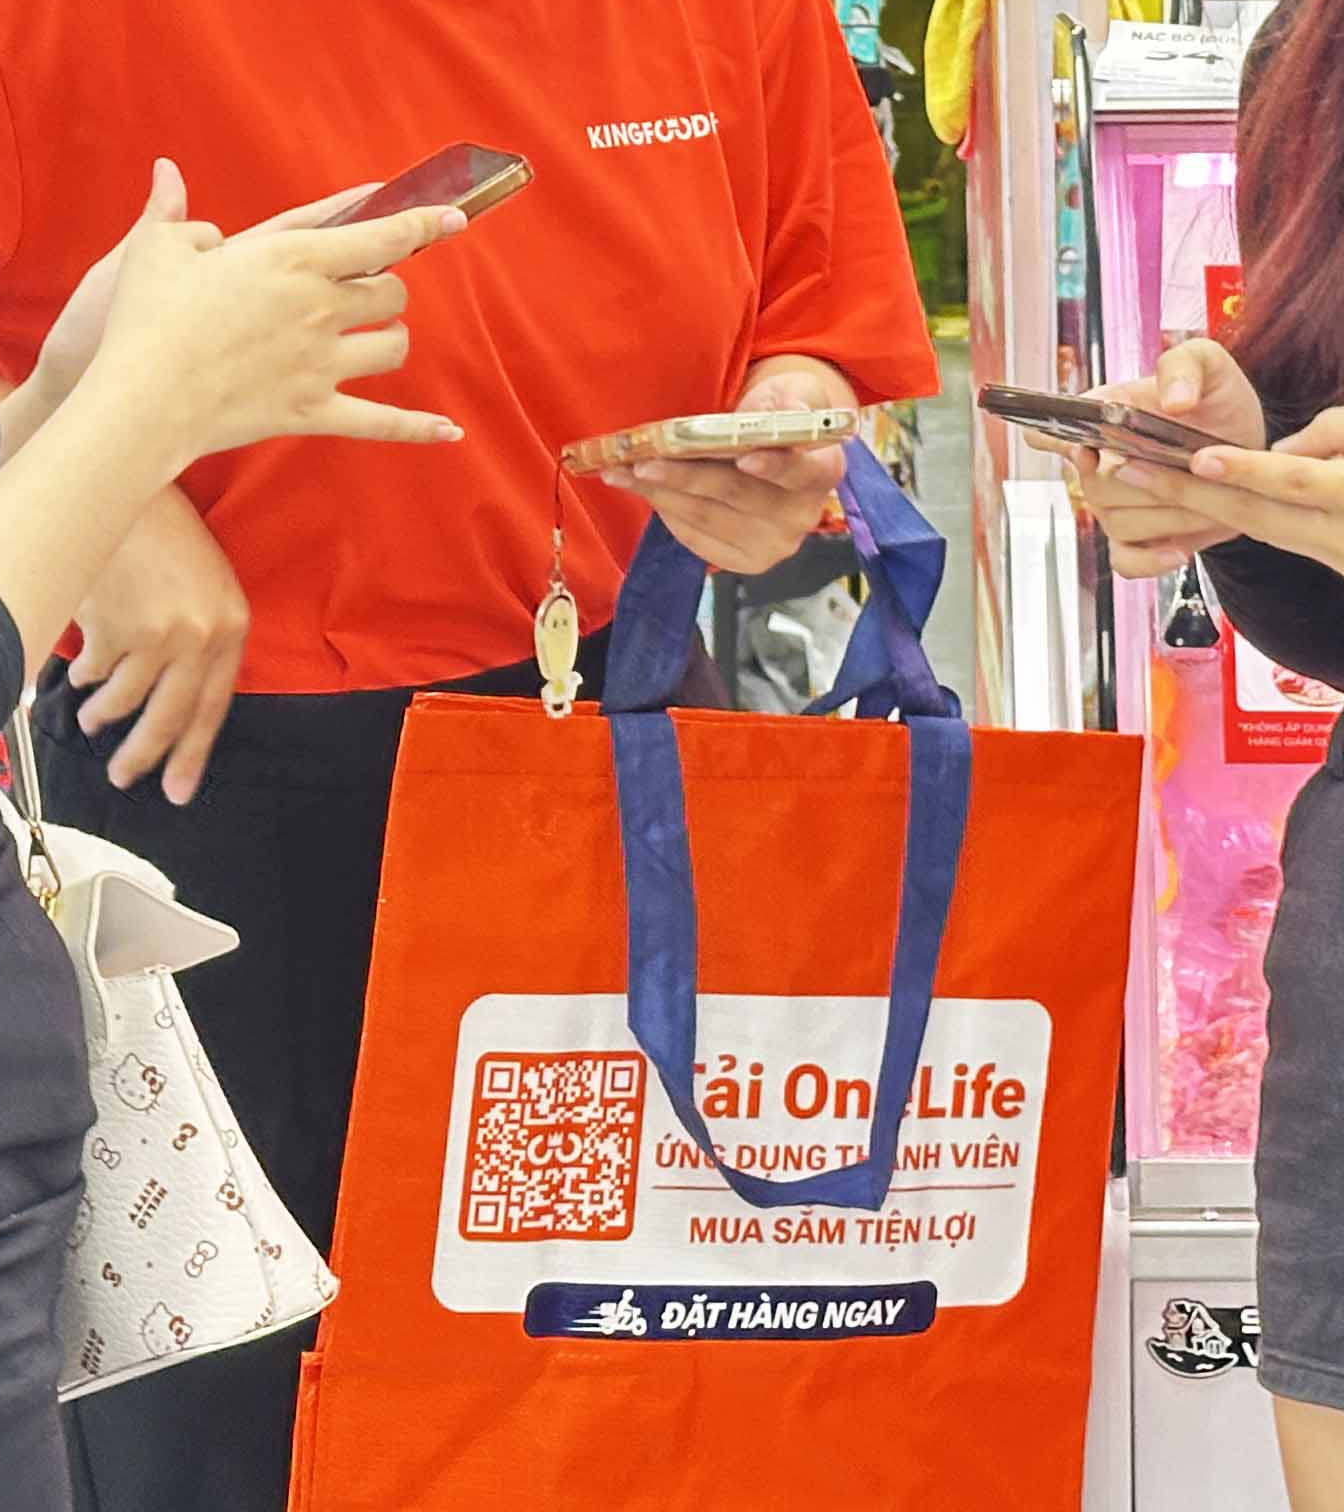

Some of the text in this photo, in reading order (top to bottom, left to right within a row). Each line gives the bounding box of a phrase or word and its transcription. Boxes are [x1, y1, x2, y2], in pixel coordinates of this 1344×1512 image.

[692, 1054, 1026, 1120] ải OnLife
[735, 1144, 827, 1178] DỤNG
[835, 1143, 941, 1170] THNH
[951, 1133, 1020, 1169] VIÊN
[689, 1216, 764, 1244] MUA
[856, 1210, 921, 1252] TIỆN
[927, 1212, 976, 1249] LỢI
[661, 1292, 906, 1336] ĐẶT HÀNG NGAY
